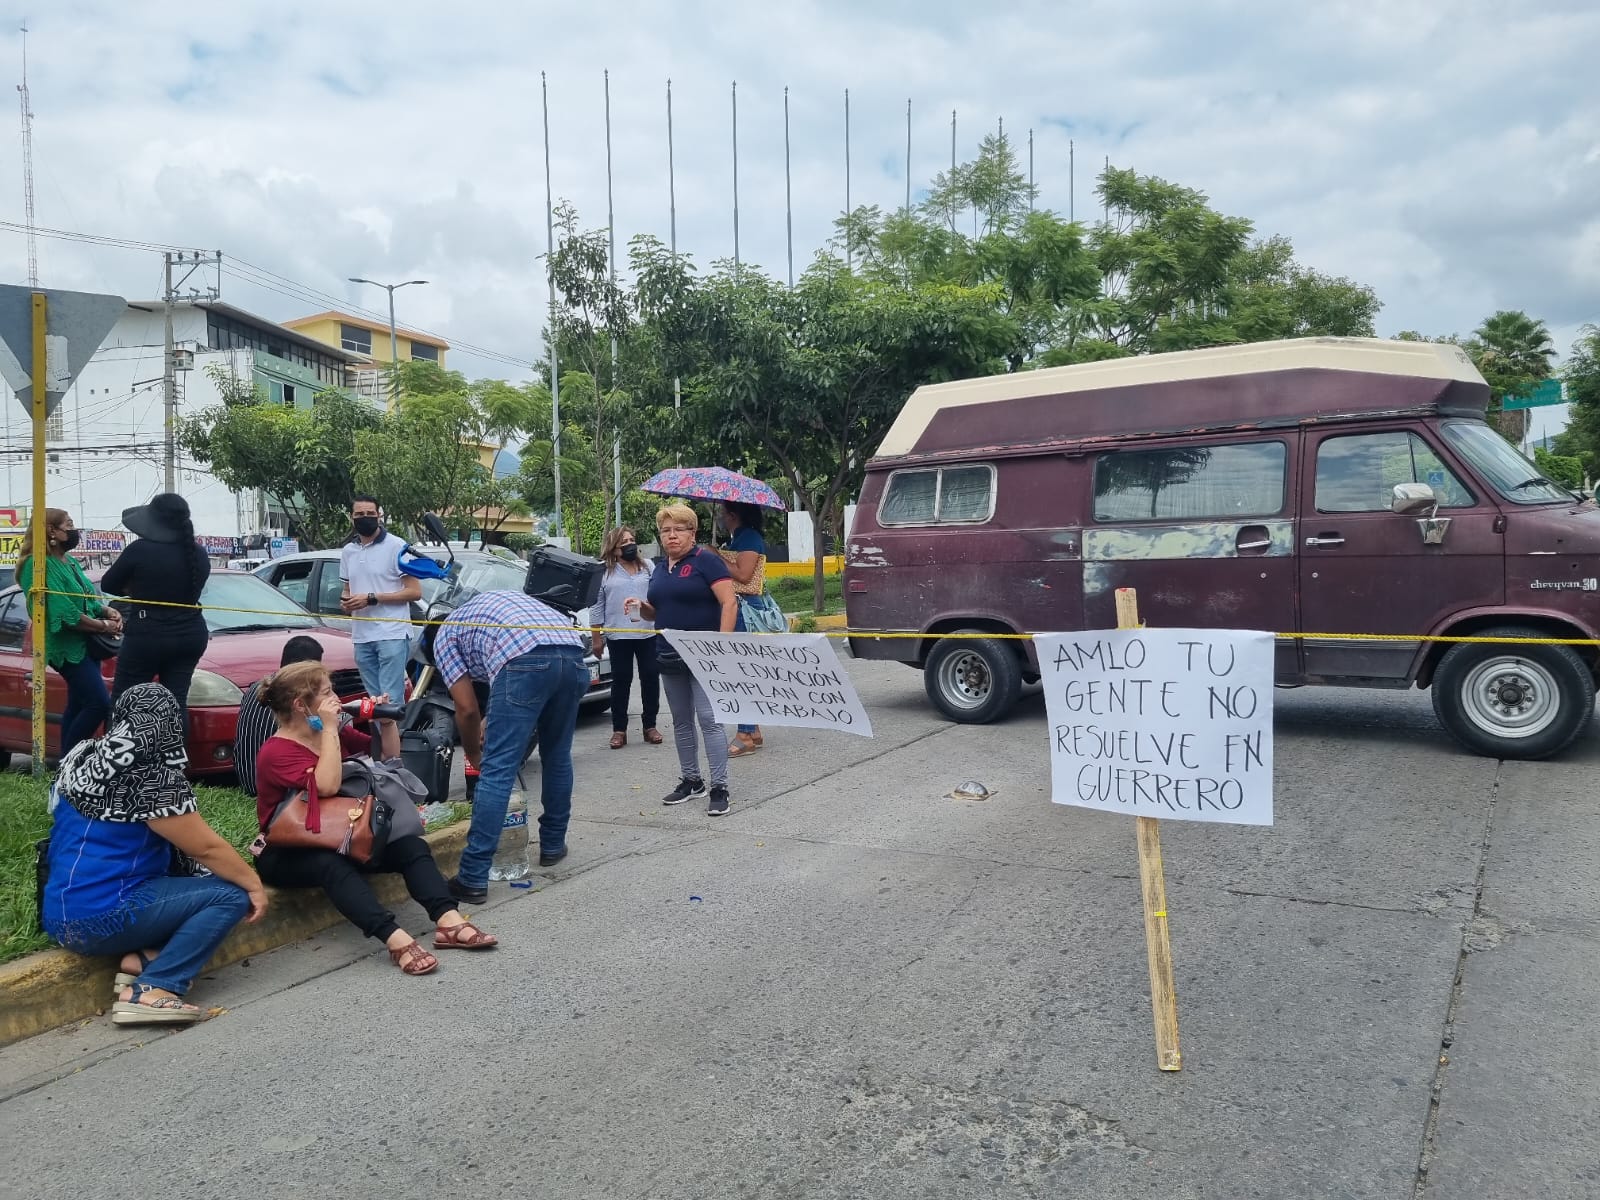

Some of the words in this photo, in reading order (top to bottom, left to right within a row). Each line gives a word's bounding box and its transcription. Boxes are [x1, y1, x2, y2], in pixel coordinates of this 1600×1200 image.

[86, 539, 121, 550] DERECHA
[1582, 578, 1597, 590] 30
[679, 638, 820, 664] FUNCIONARIOS
[1053, 638, 1146, 672] AMLO
[1178, 641, 1235, 677] TU
[698, 658, 725, 675] DE
[737, 661, 842, 687] EDUCACIÓN
[709, 679, 800, 701] CUMPLAN
[808, 690, 846, 705] CON
[1065, 679, 1181, 717] GENTE
[1208, 685, 1257, 719] NO
[717, 698, 740, 714] SU
[751, 700, 853, 725] TRABAJO
[1056, 724, 1200, 769] RESUELVE
[1077, 763, 1243, 811] GUERRERO
